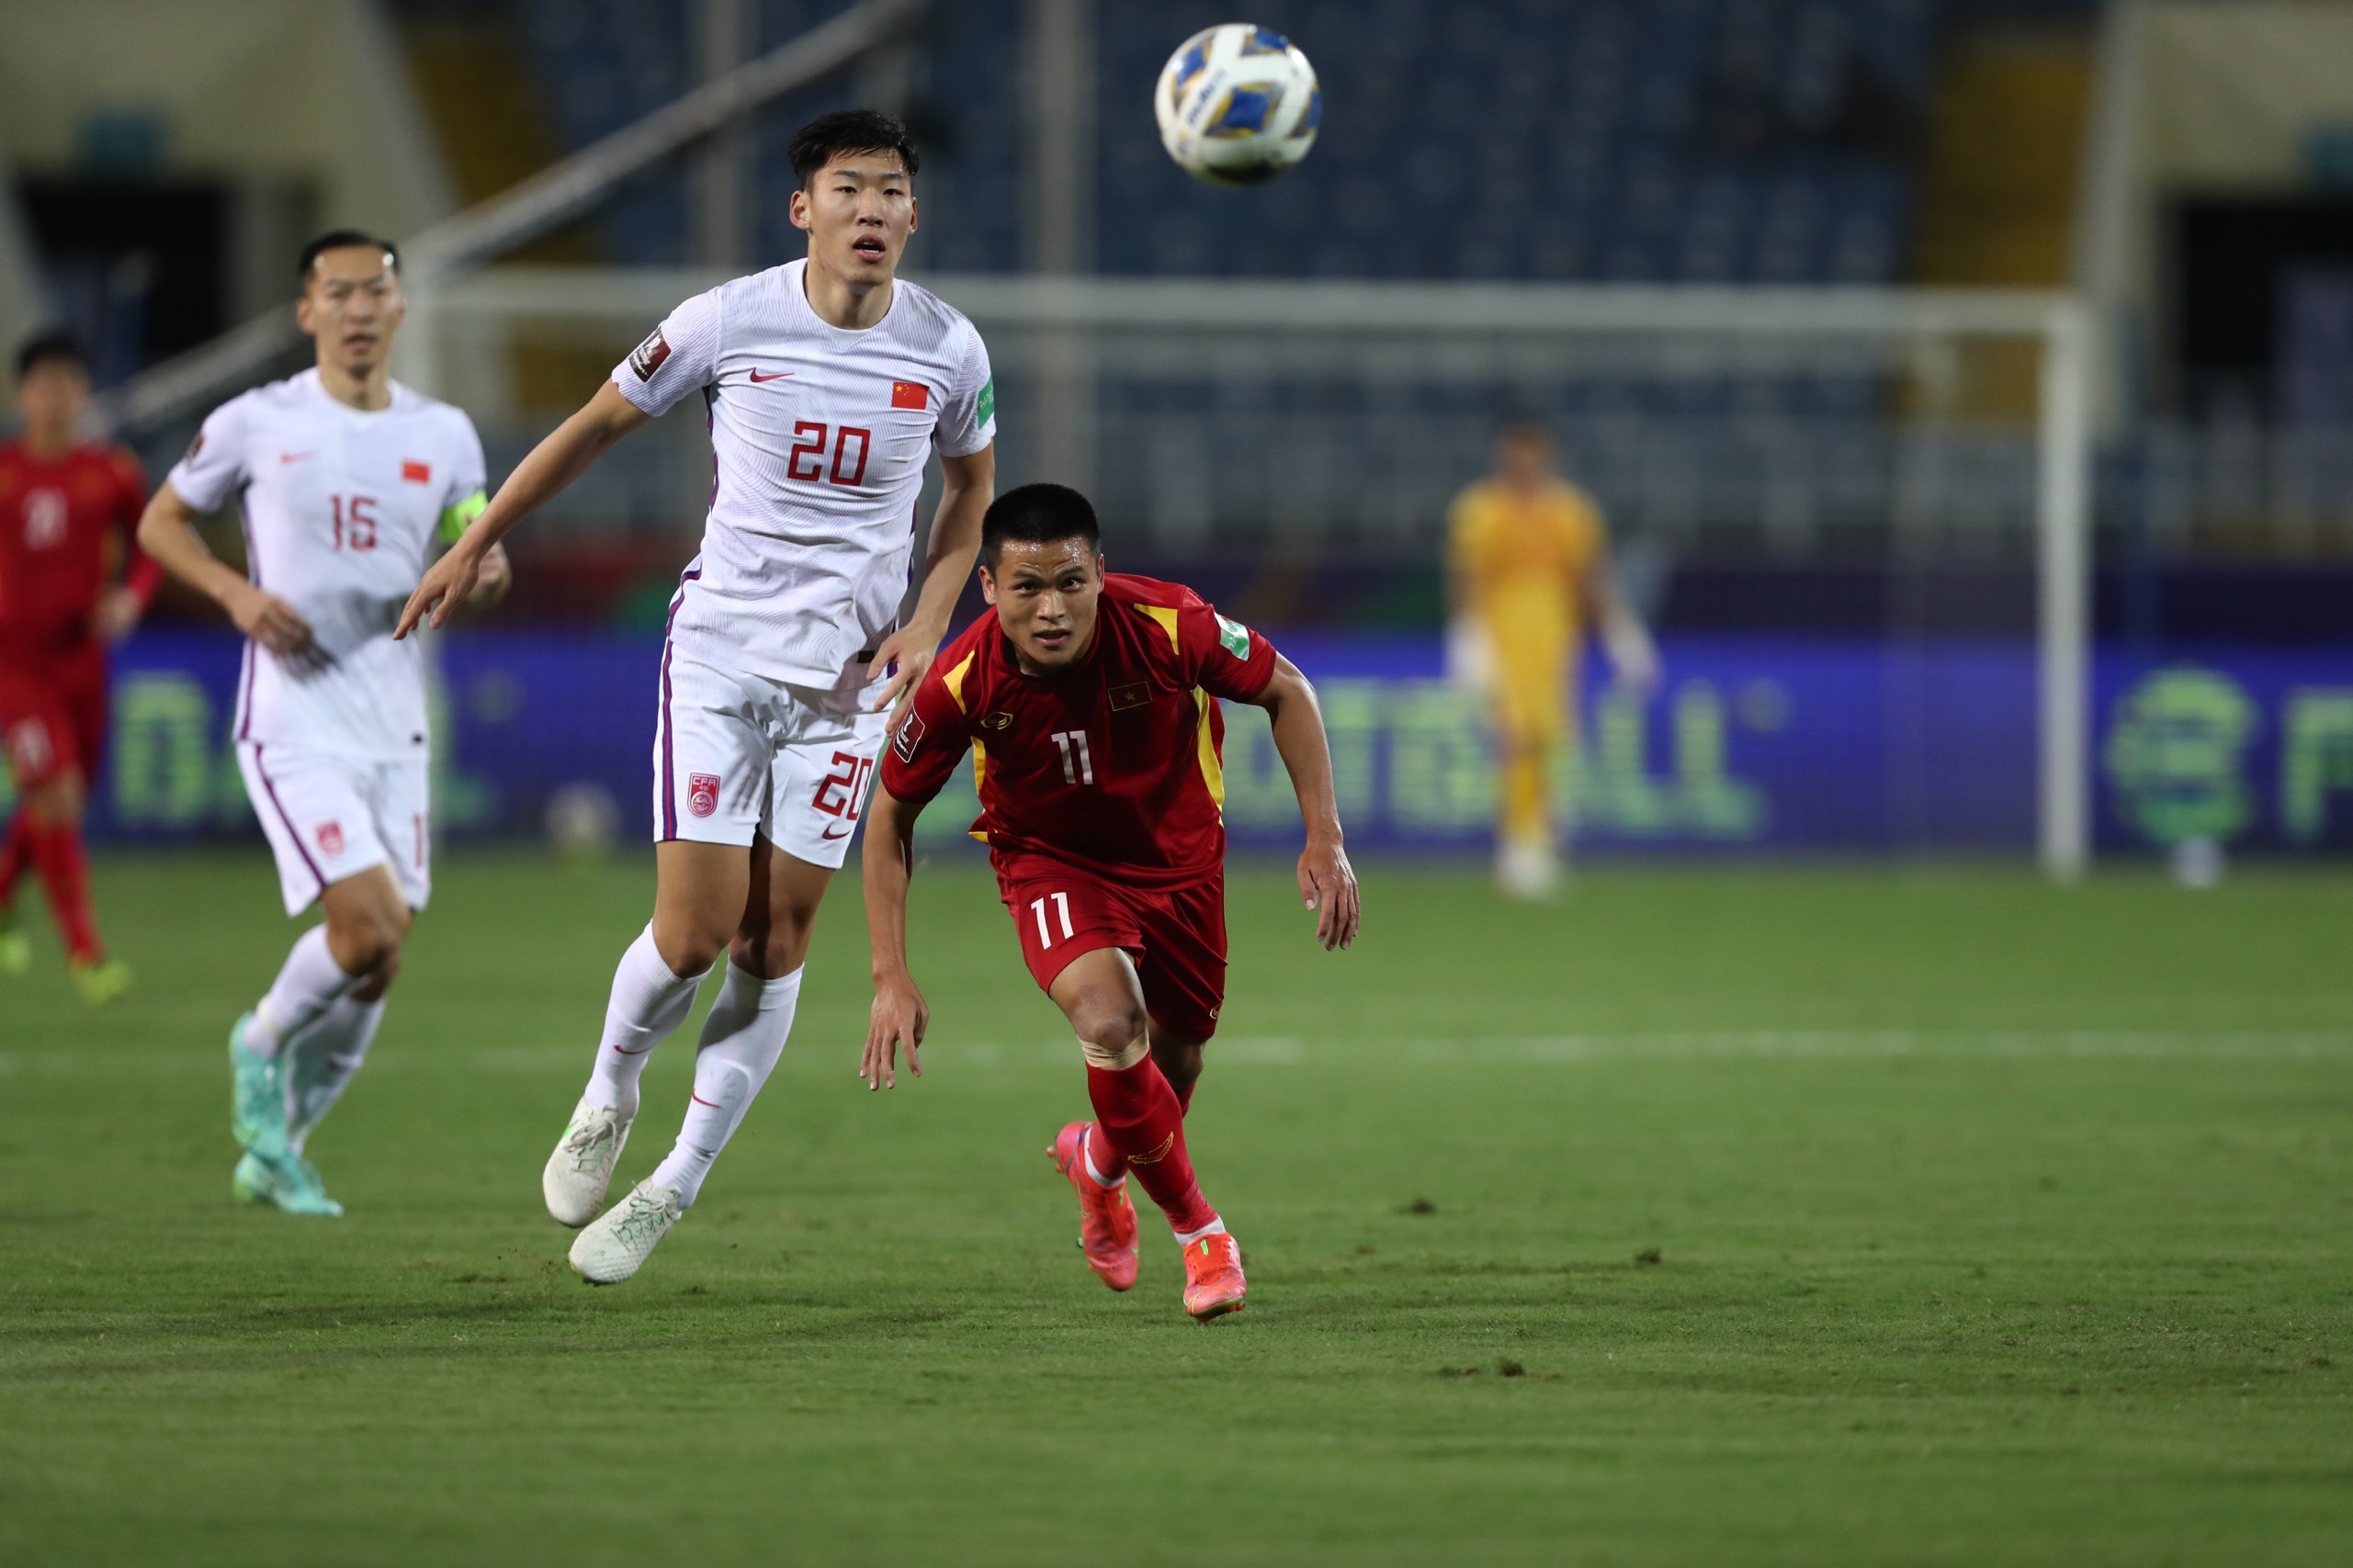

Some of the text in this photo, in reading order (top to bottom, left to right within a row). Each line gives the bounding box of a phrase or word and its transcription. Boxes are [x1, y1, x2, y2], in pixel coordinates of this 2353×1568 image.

[787, 421, 871, 486] 20
[329, 493, 378, 552] 15
[811, 750, 873, 821] 20
[1051, 729, 1093, 784] 11
[1030, 891, 1074, 951] 11
